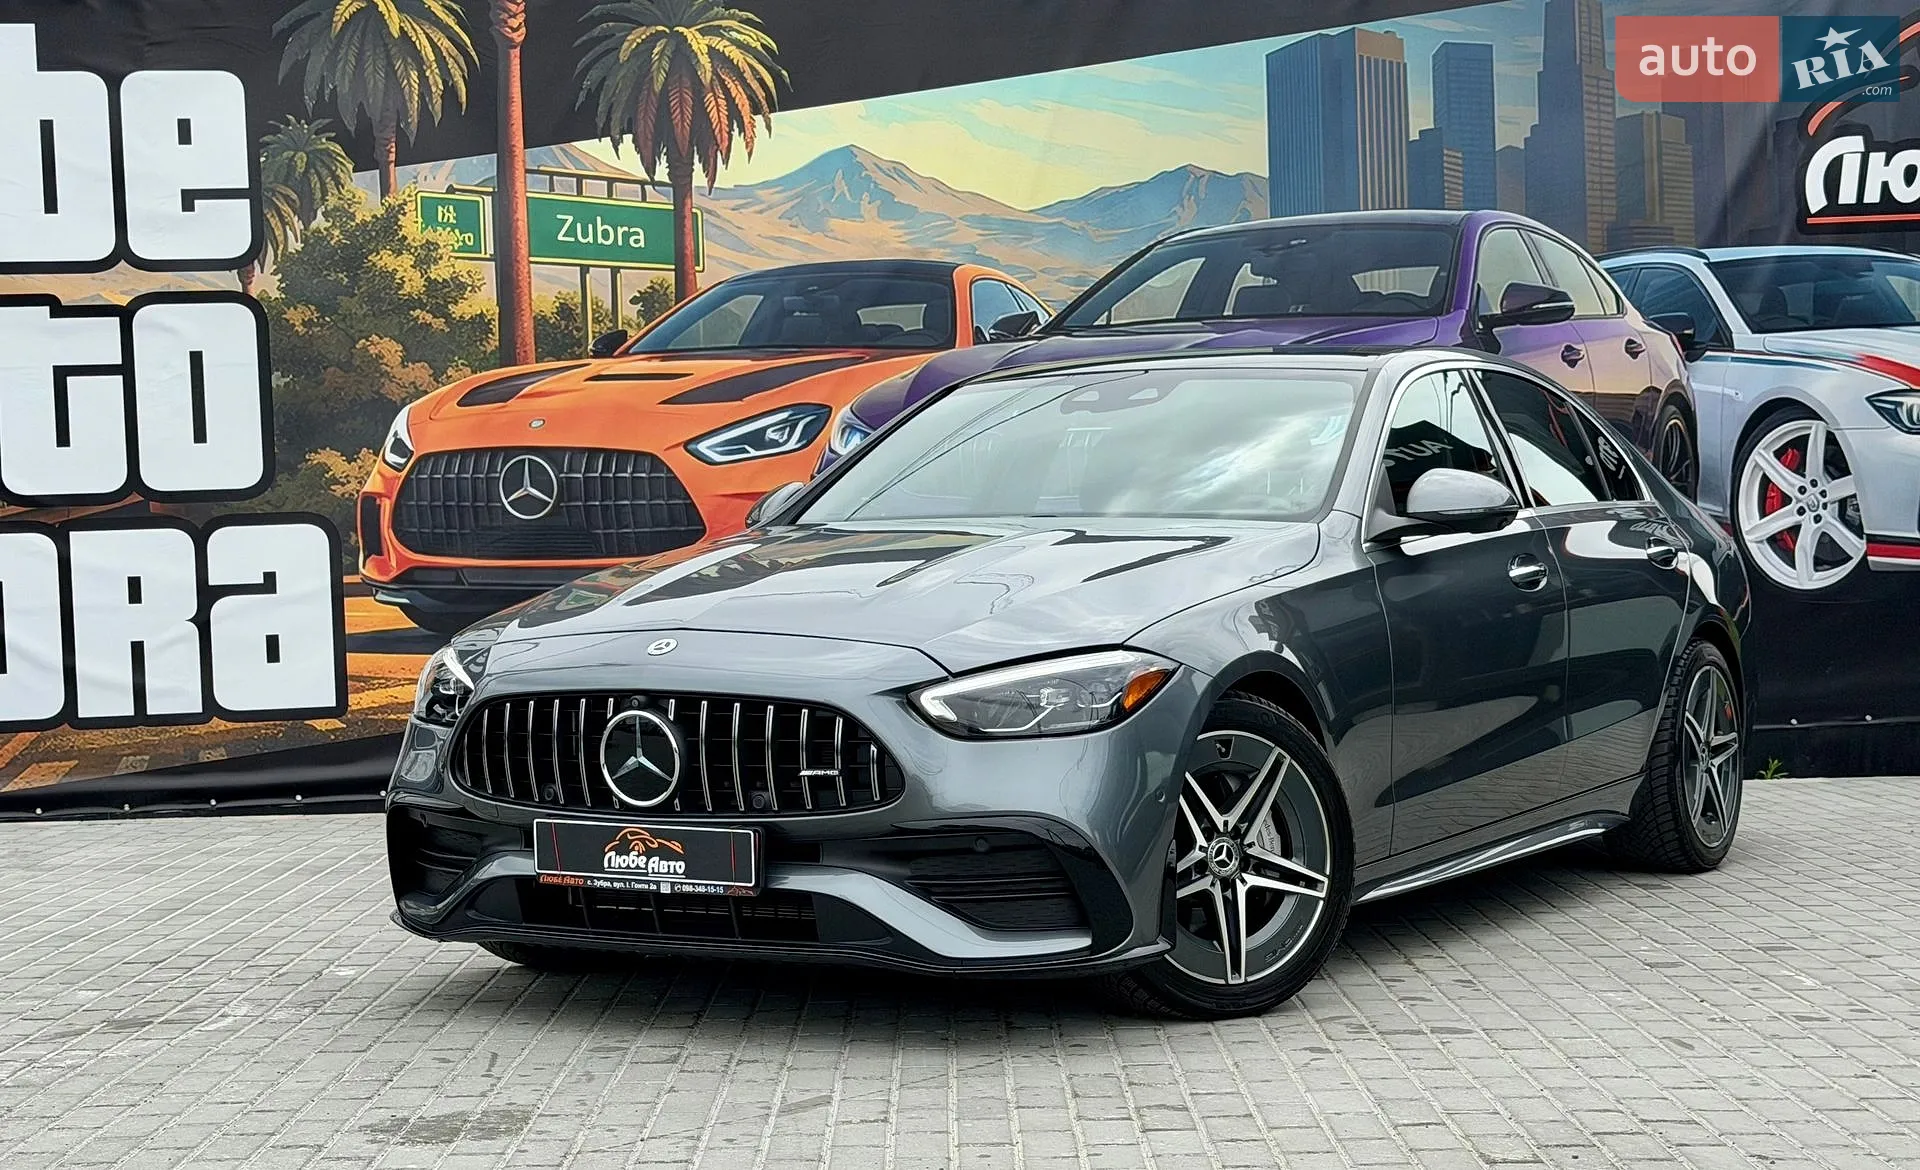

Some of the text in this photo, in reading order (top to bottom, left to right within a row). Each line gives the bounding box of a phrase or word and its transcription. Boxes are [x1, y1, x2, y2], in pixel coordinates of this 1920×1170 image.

[555, 213, 646, 249] Zubra
[603, 850, 686, 874] Любе Авто
